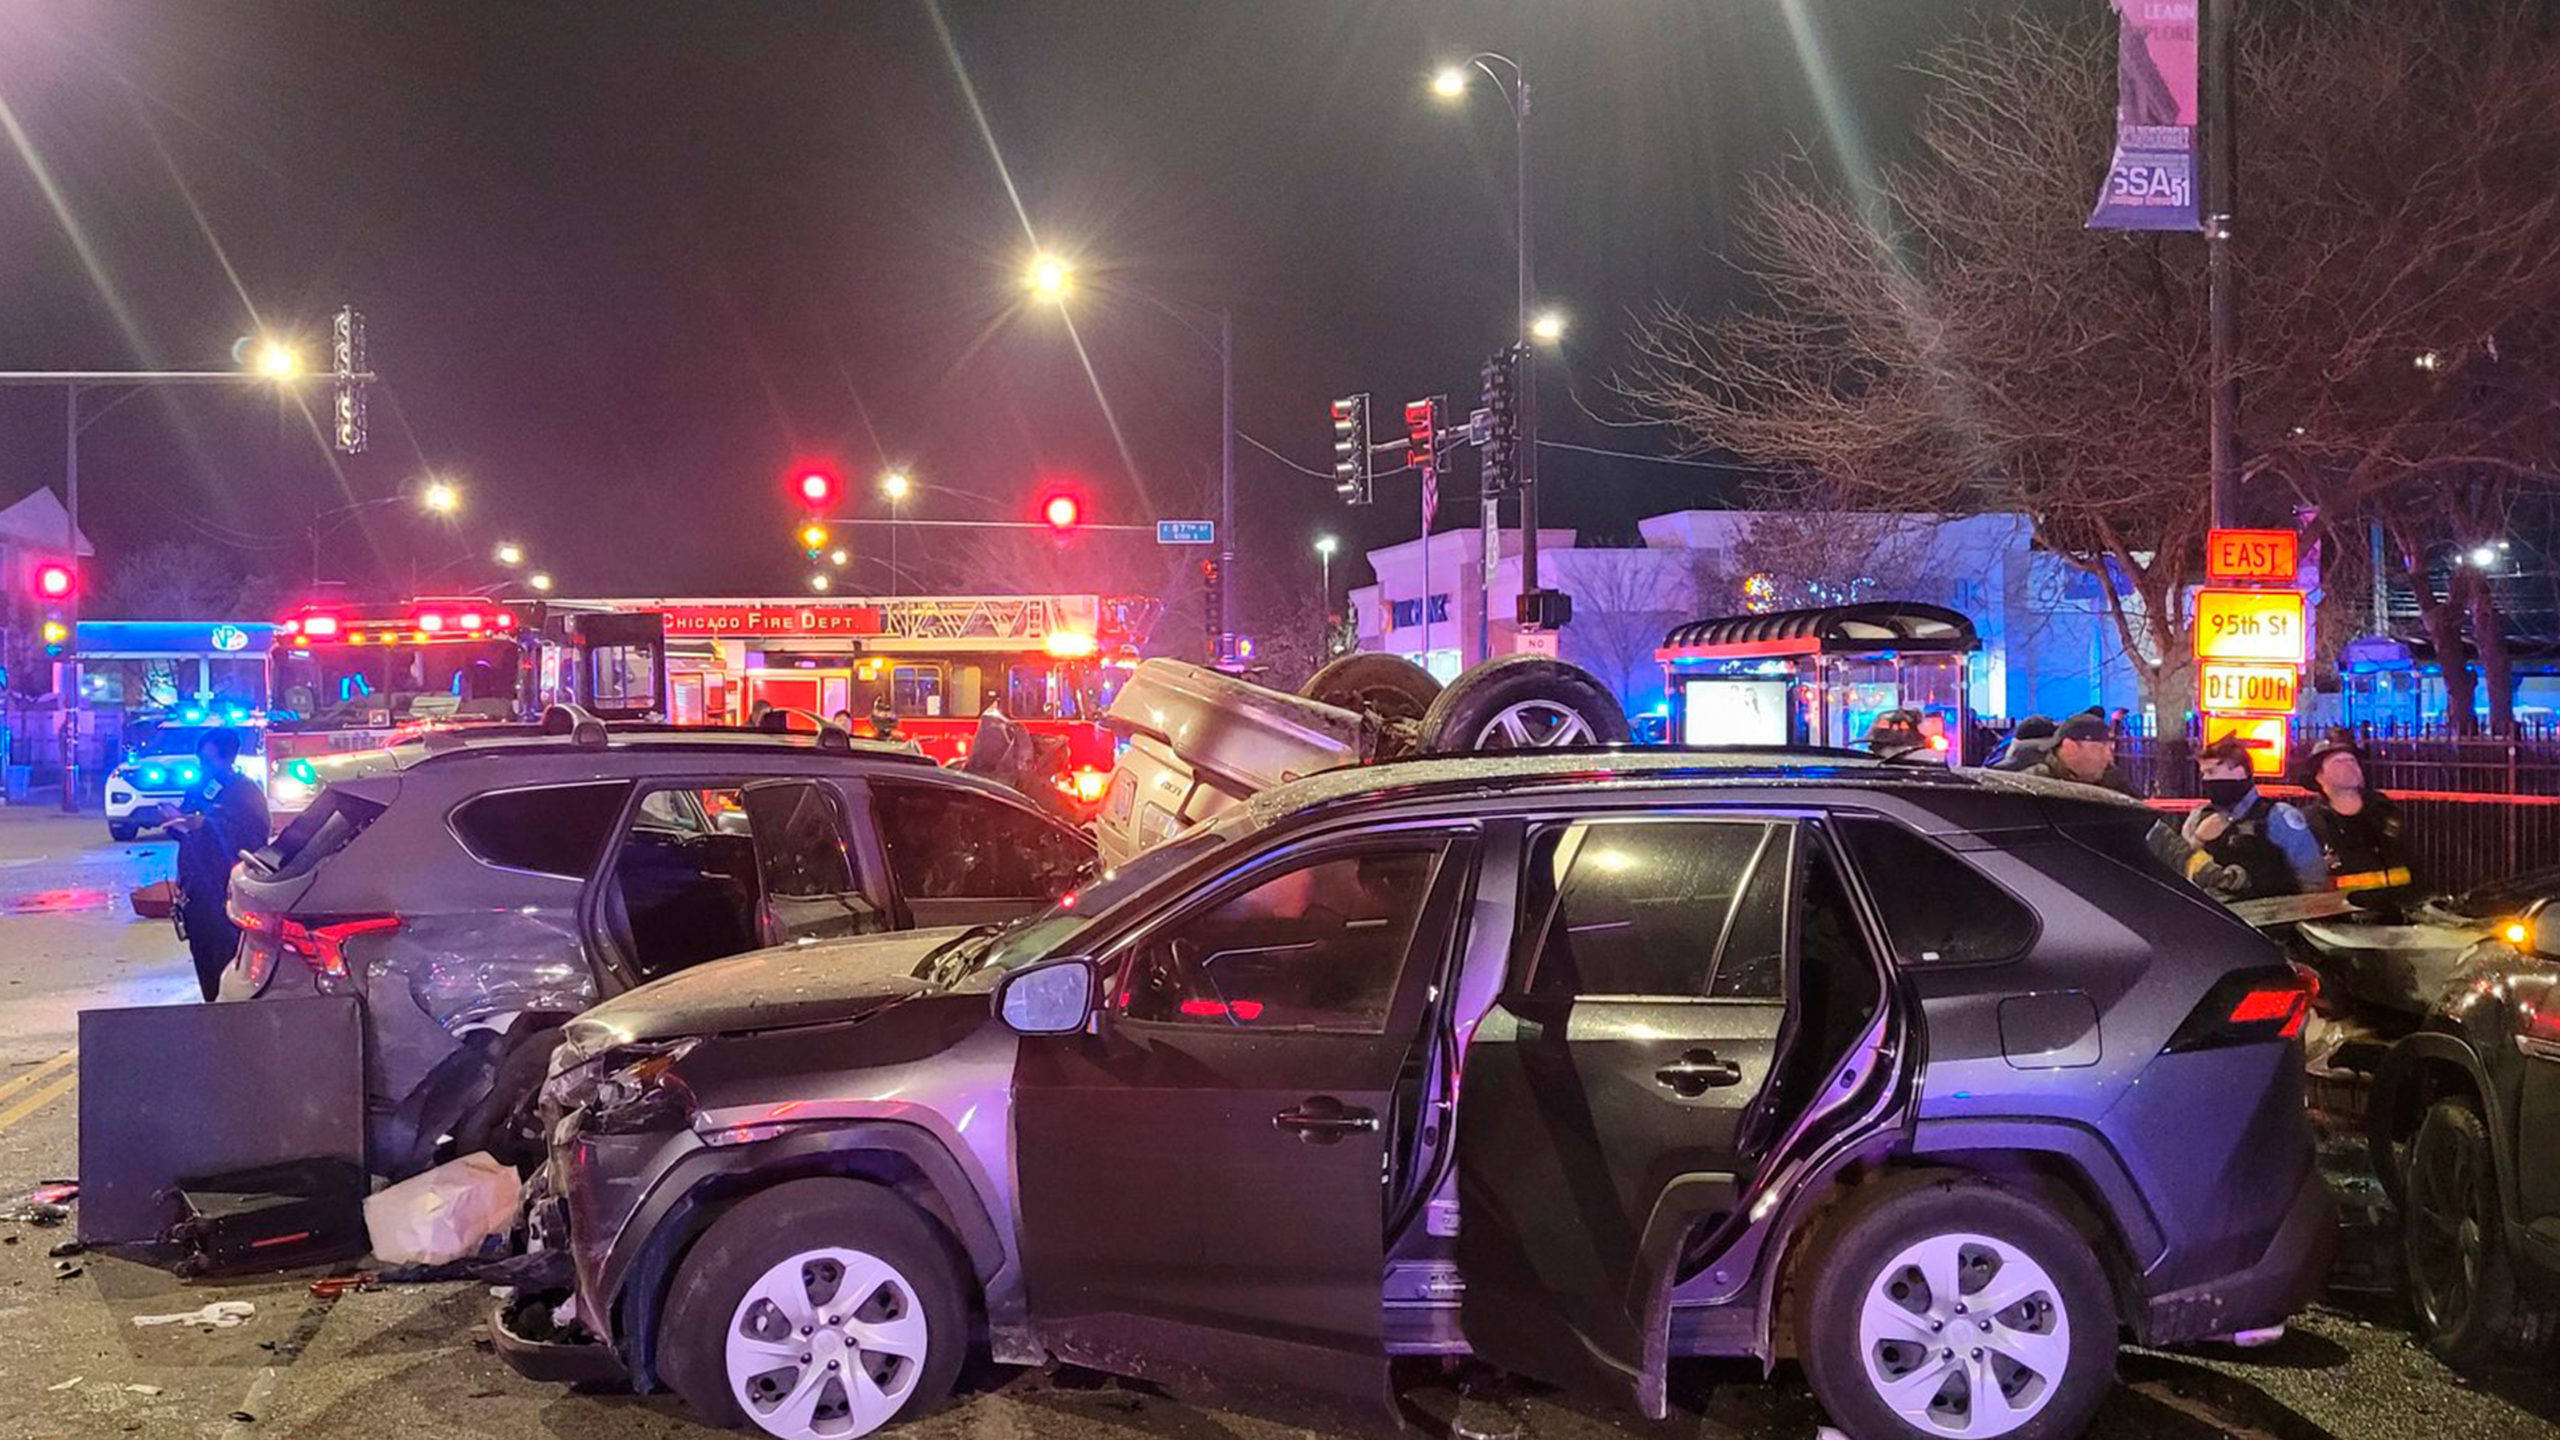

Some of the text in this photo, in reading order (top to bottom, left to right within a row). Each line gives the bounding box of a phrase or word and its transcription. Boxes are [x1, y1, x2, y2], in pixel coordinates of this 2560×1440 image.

[2144, 3, 2194, 20] LEARN
[2222, 543, 2279, 570] EAST
[664, 612, 740, 629] CHICAGO
[748, 612, 793, 629] FIRE
[2211, 614, 2288, 636] 95th St
[1528, 639, 1544, 649] NO
[2207, 674, 2288, 701] DETOUR
